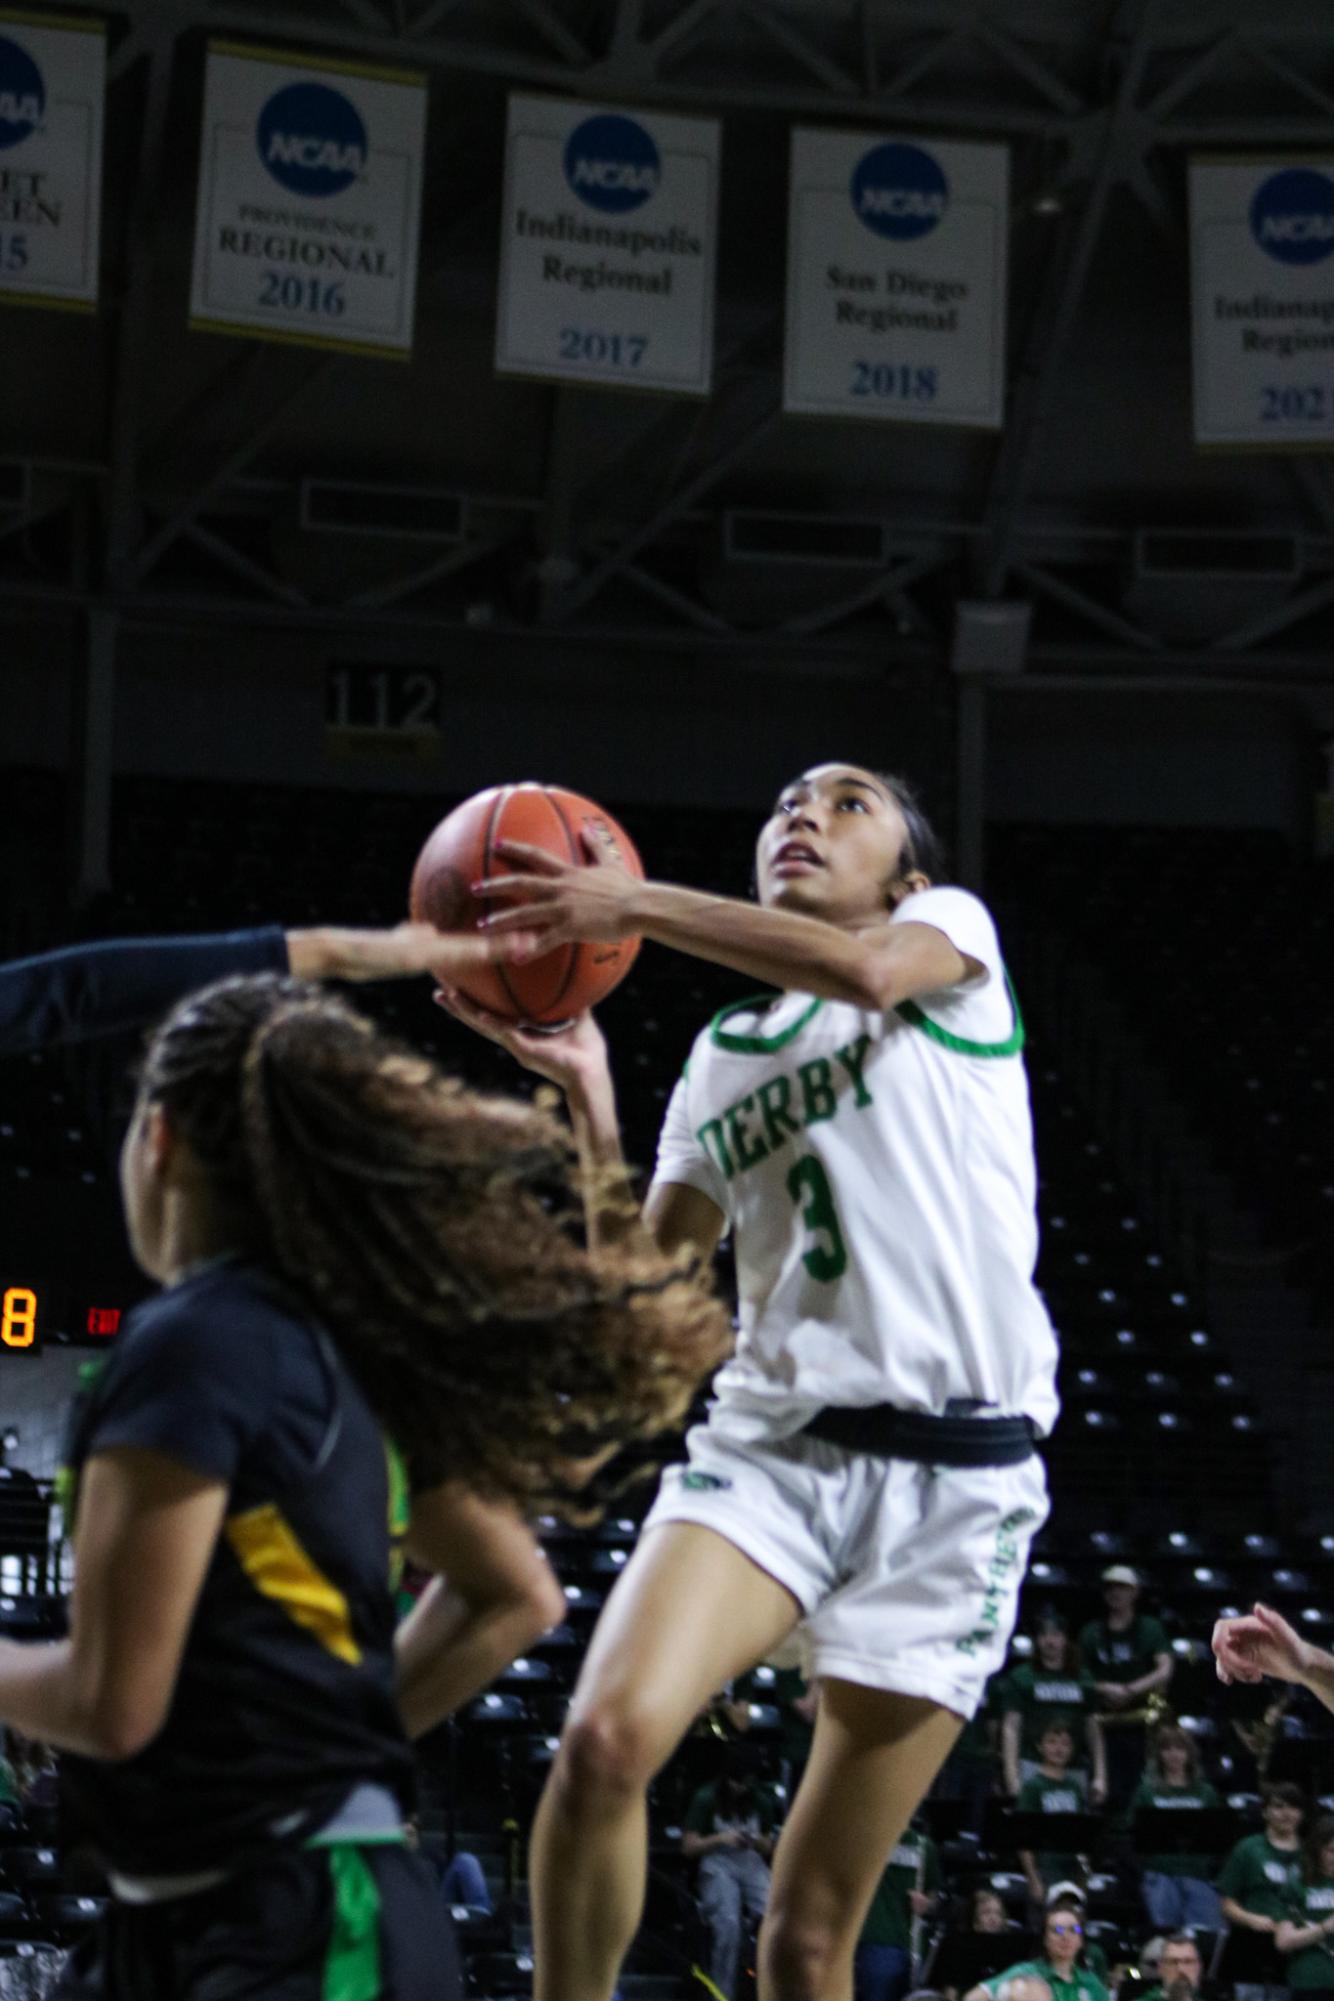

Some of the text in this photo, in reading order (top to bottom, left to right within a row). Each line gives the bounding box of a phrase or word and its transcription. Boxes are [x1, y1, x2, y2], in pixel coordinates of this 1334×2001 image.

[267, 131, 363, 176] NCAA
[573, 156, 660, 194] NCAA
[861, 184, 945, 220] NCAA
[219, 225, 394, 278] REGIONAL
[516, 208, 701, 257] Indianapolis
[259, 270, 345, 317] 2016
[543, 254, 673, 295] Regional
[826, 264, 970, 304] San Diego
[836, 298, 957, 334] Regional
[560, 327, 649, 368] 2017
[851, 359, 939, 401] 2018
[1260, 384, 1334, 422] 202
[331, 669, 437, 733] 112
[696, 1032, 874, 1182] DERBY
[787, 1153, 844, 1283] 3
[1, 1286, 37, 1348] 8
